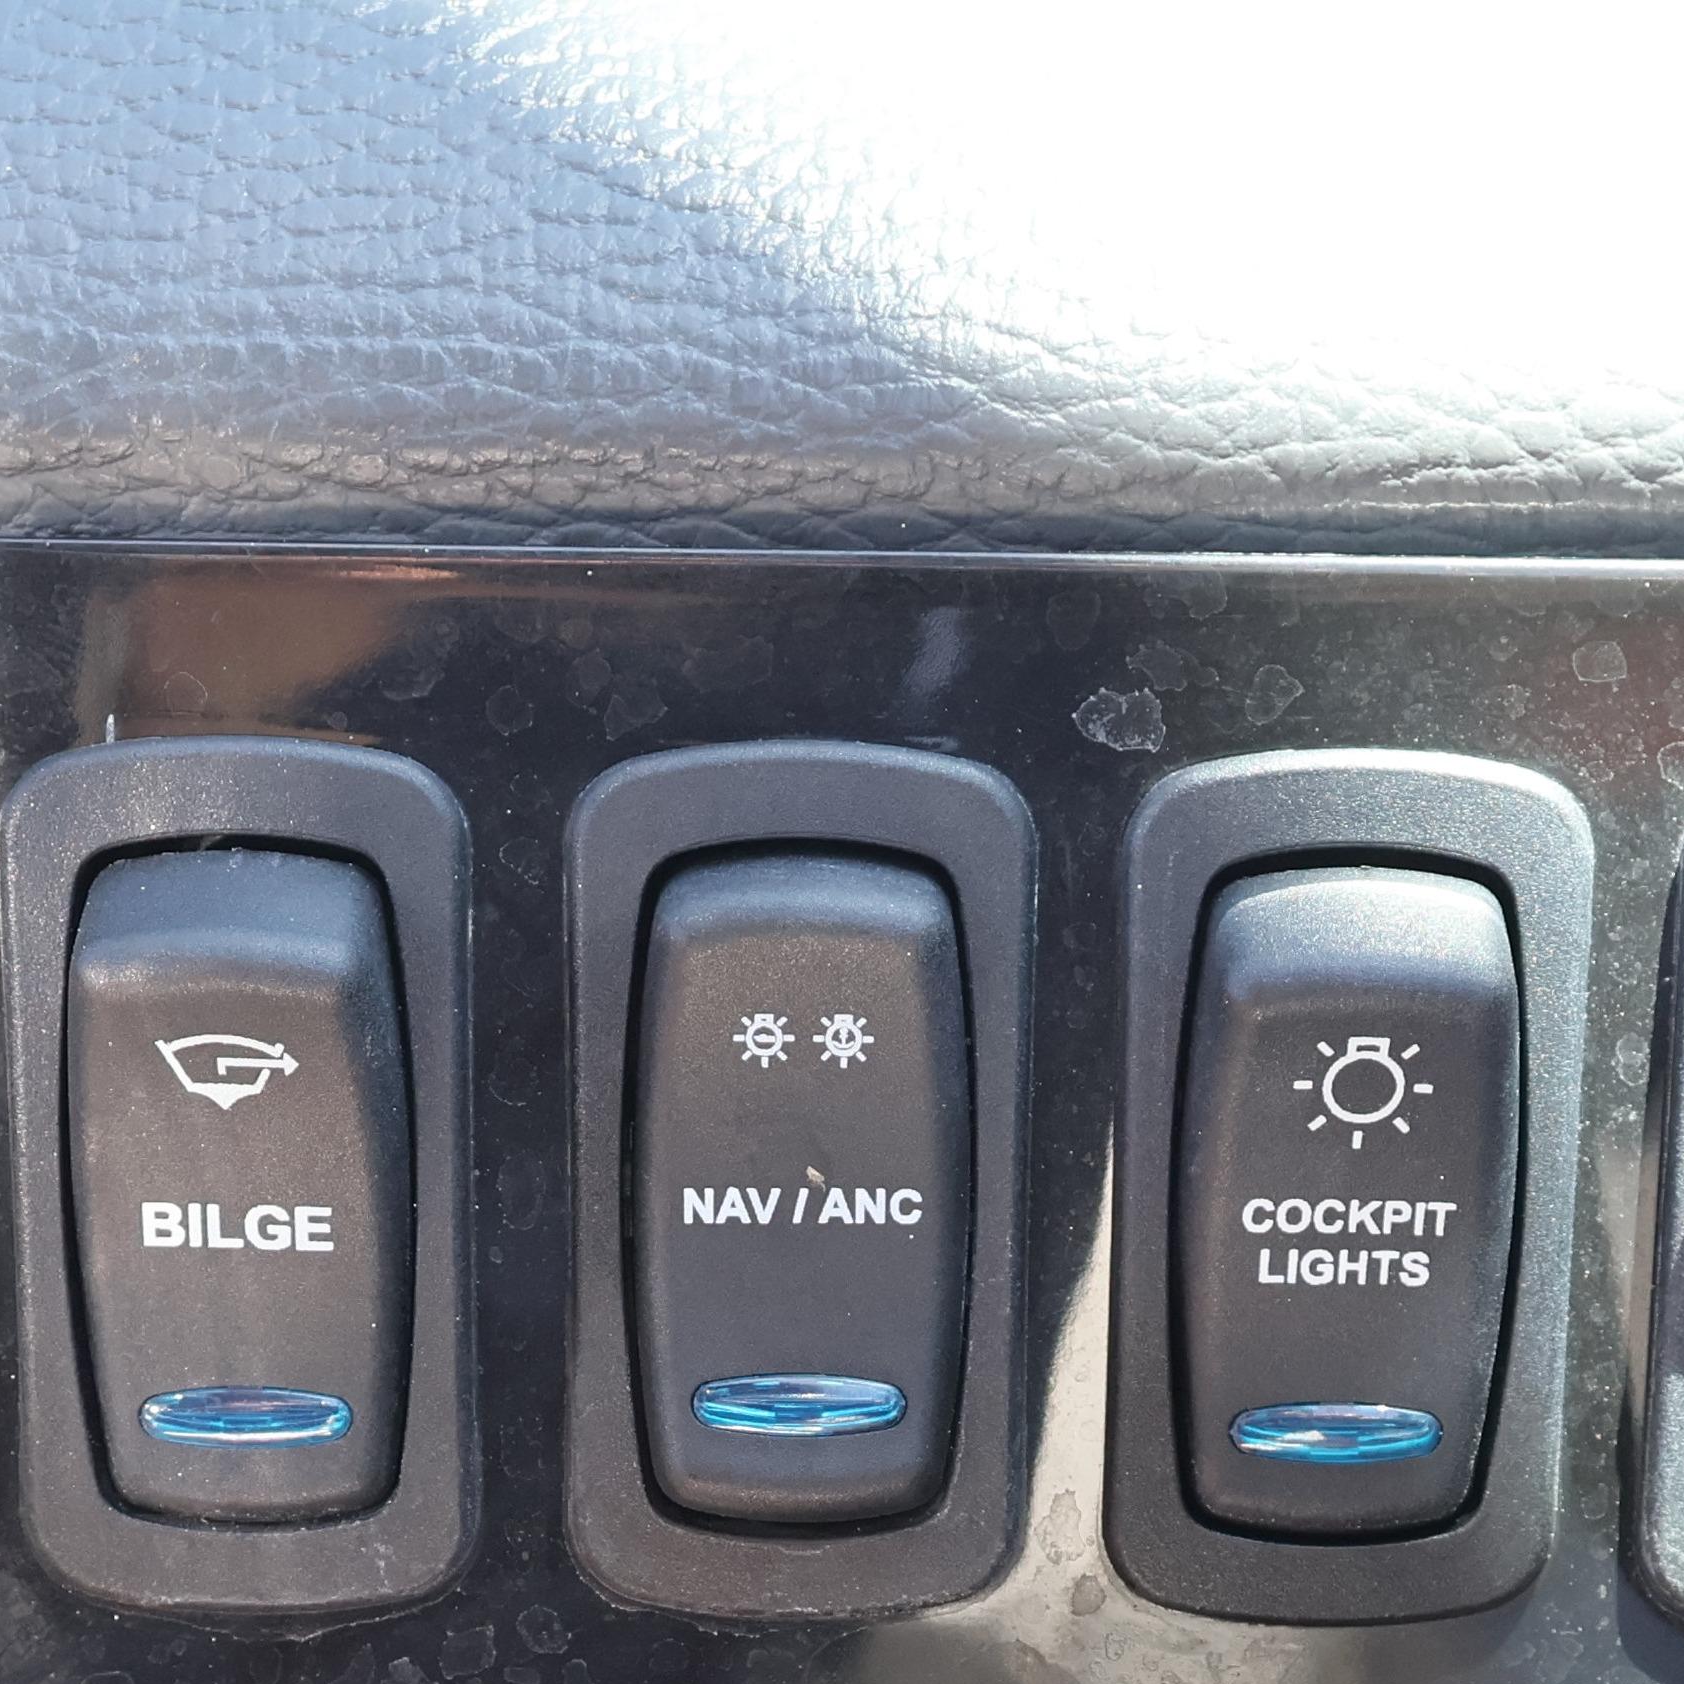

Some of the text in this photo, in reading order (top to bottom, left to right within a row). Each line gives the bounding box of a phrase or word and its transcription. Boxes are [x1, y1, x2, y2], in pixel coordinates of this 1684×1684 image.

[682, 1187, 923, 1225] NAV / ANC
[1240, 1198, 1457, 1239] COCKPIT
[141, 1202, 336, 1253] BILGE
[1257, 1247, 1430, 1289] LIGHTS
